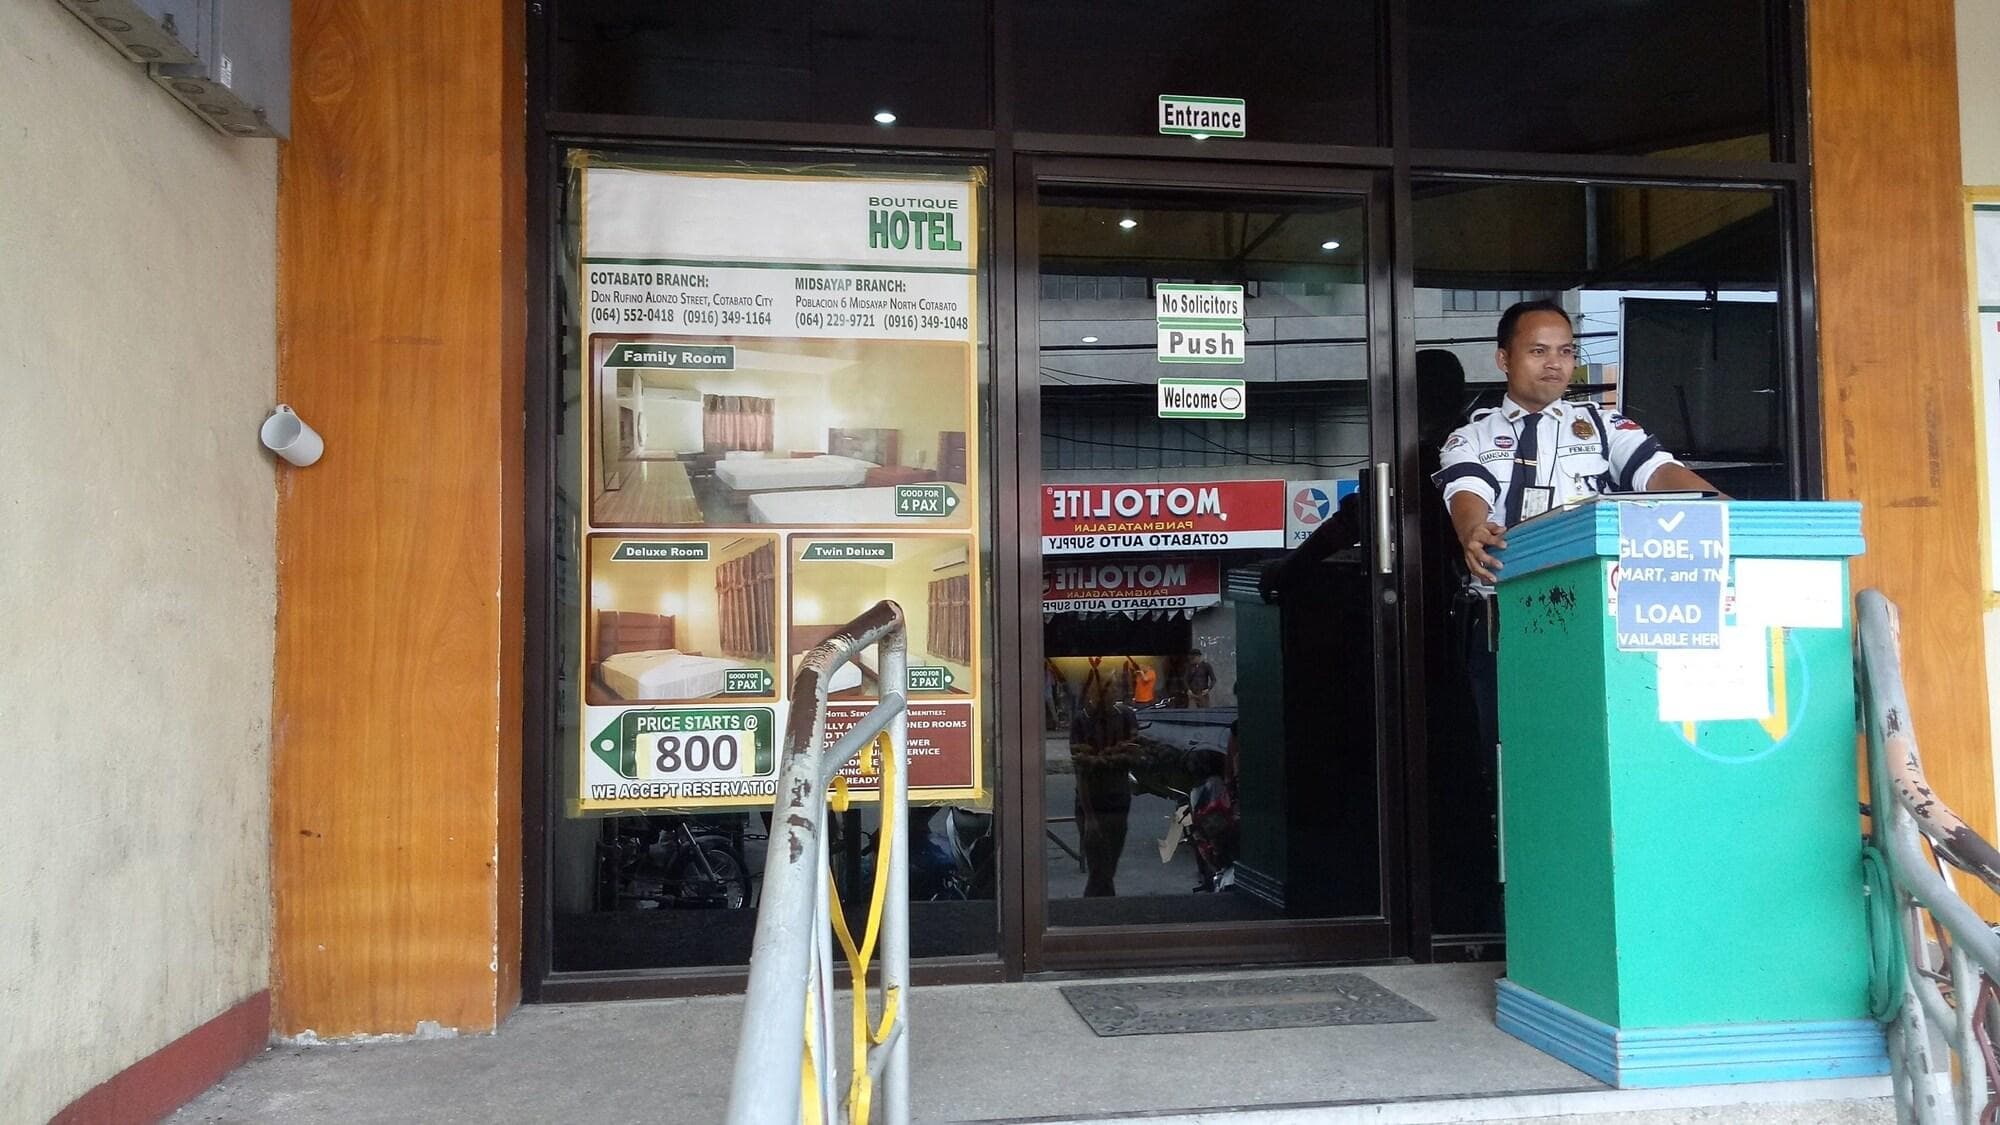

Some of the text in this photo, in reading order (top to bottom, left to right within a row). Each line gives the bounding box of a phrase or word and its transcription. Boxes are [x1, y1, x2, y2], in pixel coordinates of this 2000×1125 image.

[1165, 103, 1241, 128] Entrance
[869, 197, 959, 209] BOUTIQUE
[869, 210, 962, 251] HOTEL
[591, 272, 709, 288] COTABATO BRANCH:
[795, 278, 906, 292] MIDSAYAP BRANCH:
[840, 296, 847, 309] 6
[1162, 294, 1238, 314] No Solicitors
[591, 307, 772, 326] (064) 552-0418 (0916) 349-1164
[795, 312, 968, 330] (064) 229-9721 (0916) 349-1048
[1170, 332, 1234, 355] Push
[624, 350, 726, 365] Family Room
[1164, 387, 1218, 409] Welcome
[901, 499, 938, 511] 4 PAX
[626, 547, 704, 556] Deluxe Room
[815, 547, 885, 556] Twin Deluxe
[1619, 538, 1694, 560] GLOBE,
[1670, 568, 1698, 582] and
[1635, 603, 1702, 624] LOAD
[729, 680, 757, 689] 2 PAX
[911, 678, 938, 687] 2 PAX
[637, 714, 758, 731] PRICE STARTS @
[932, 720, 967, 728] ROOMS
[656, 735, 738, 773] 800
[592, 784, 616, 799] WE
[619, 782, 680, 799] ACCEPT
